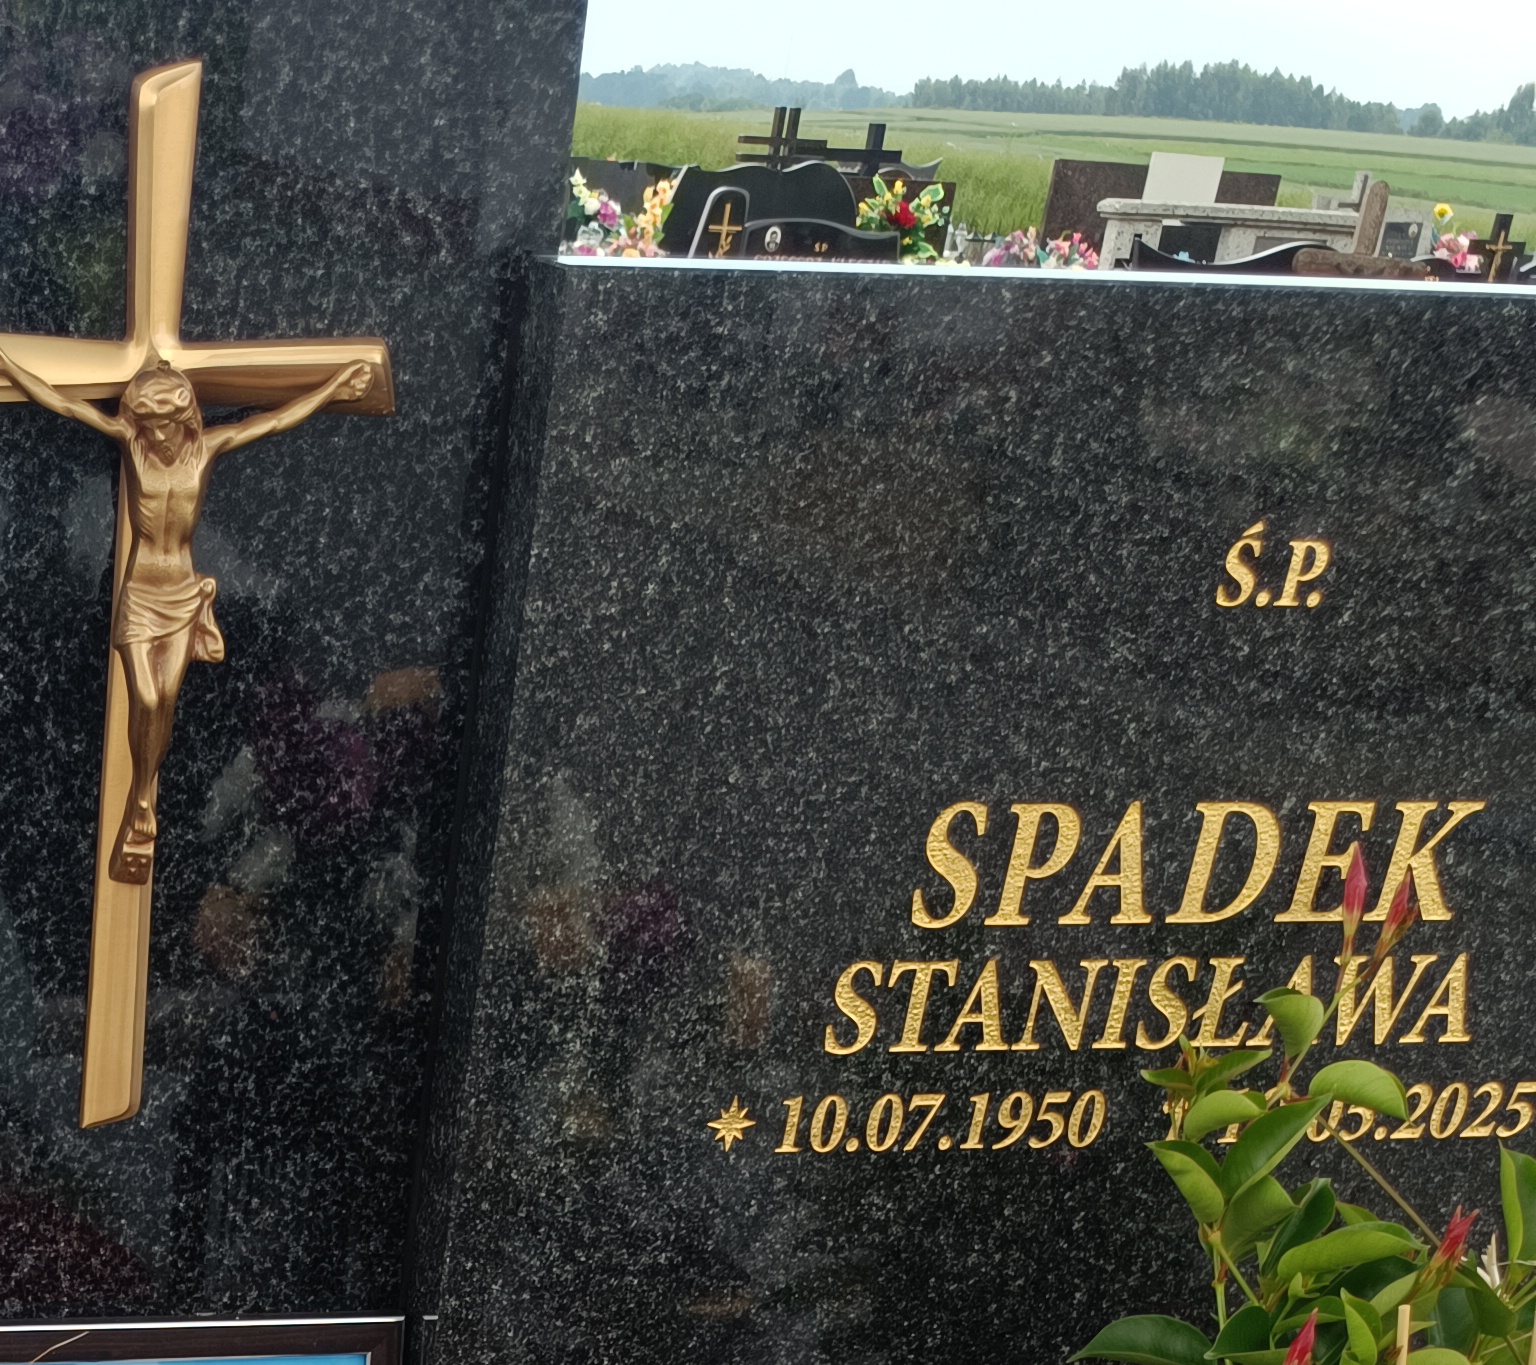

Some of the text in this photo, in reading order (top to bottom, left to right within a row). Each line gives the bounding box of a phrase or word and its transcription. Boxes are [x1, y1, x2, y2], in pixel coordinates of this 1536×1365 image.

[1215, 519, 1332, 608] Ś.P.
[910, 799, 1487, 929] SPADEK
[775, 1089, 1107, 1154] 10.07.1950
